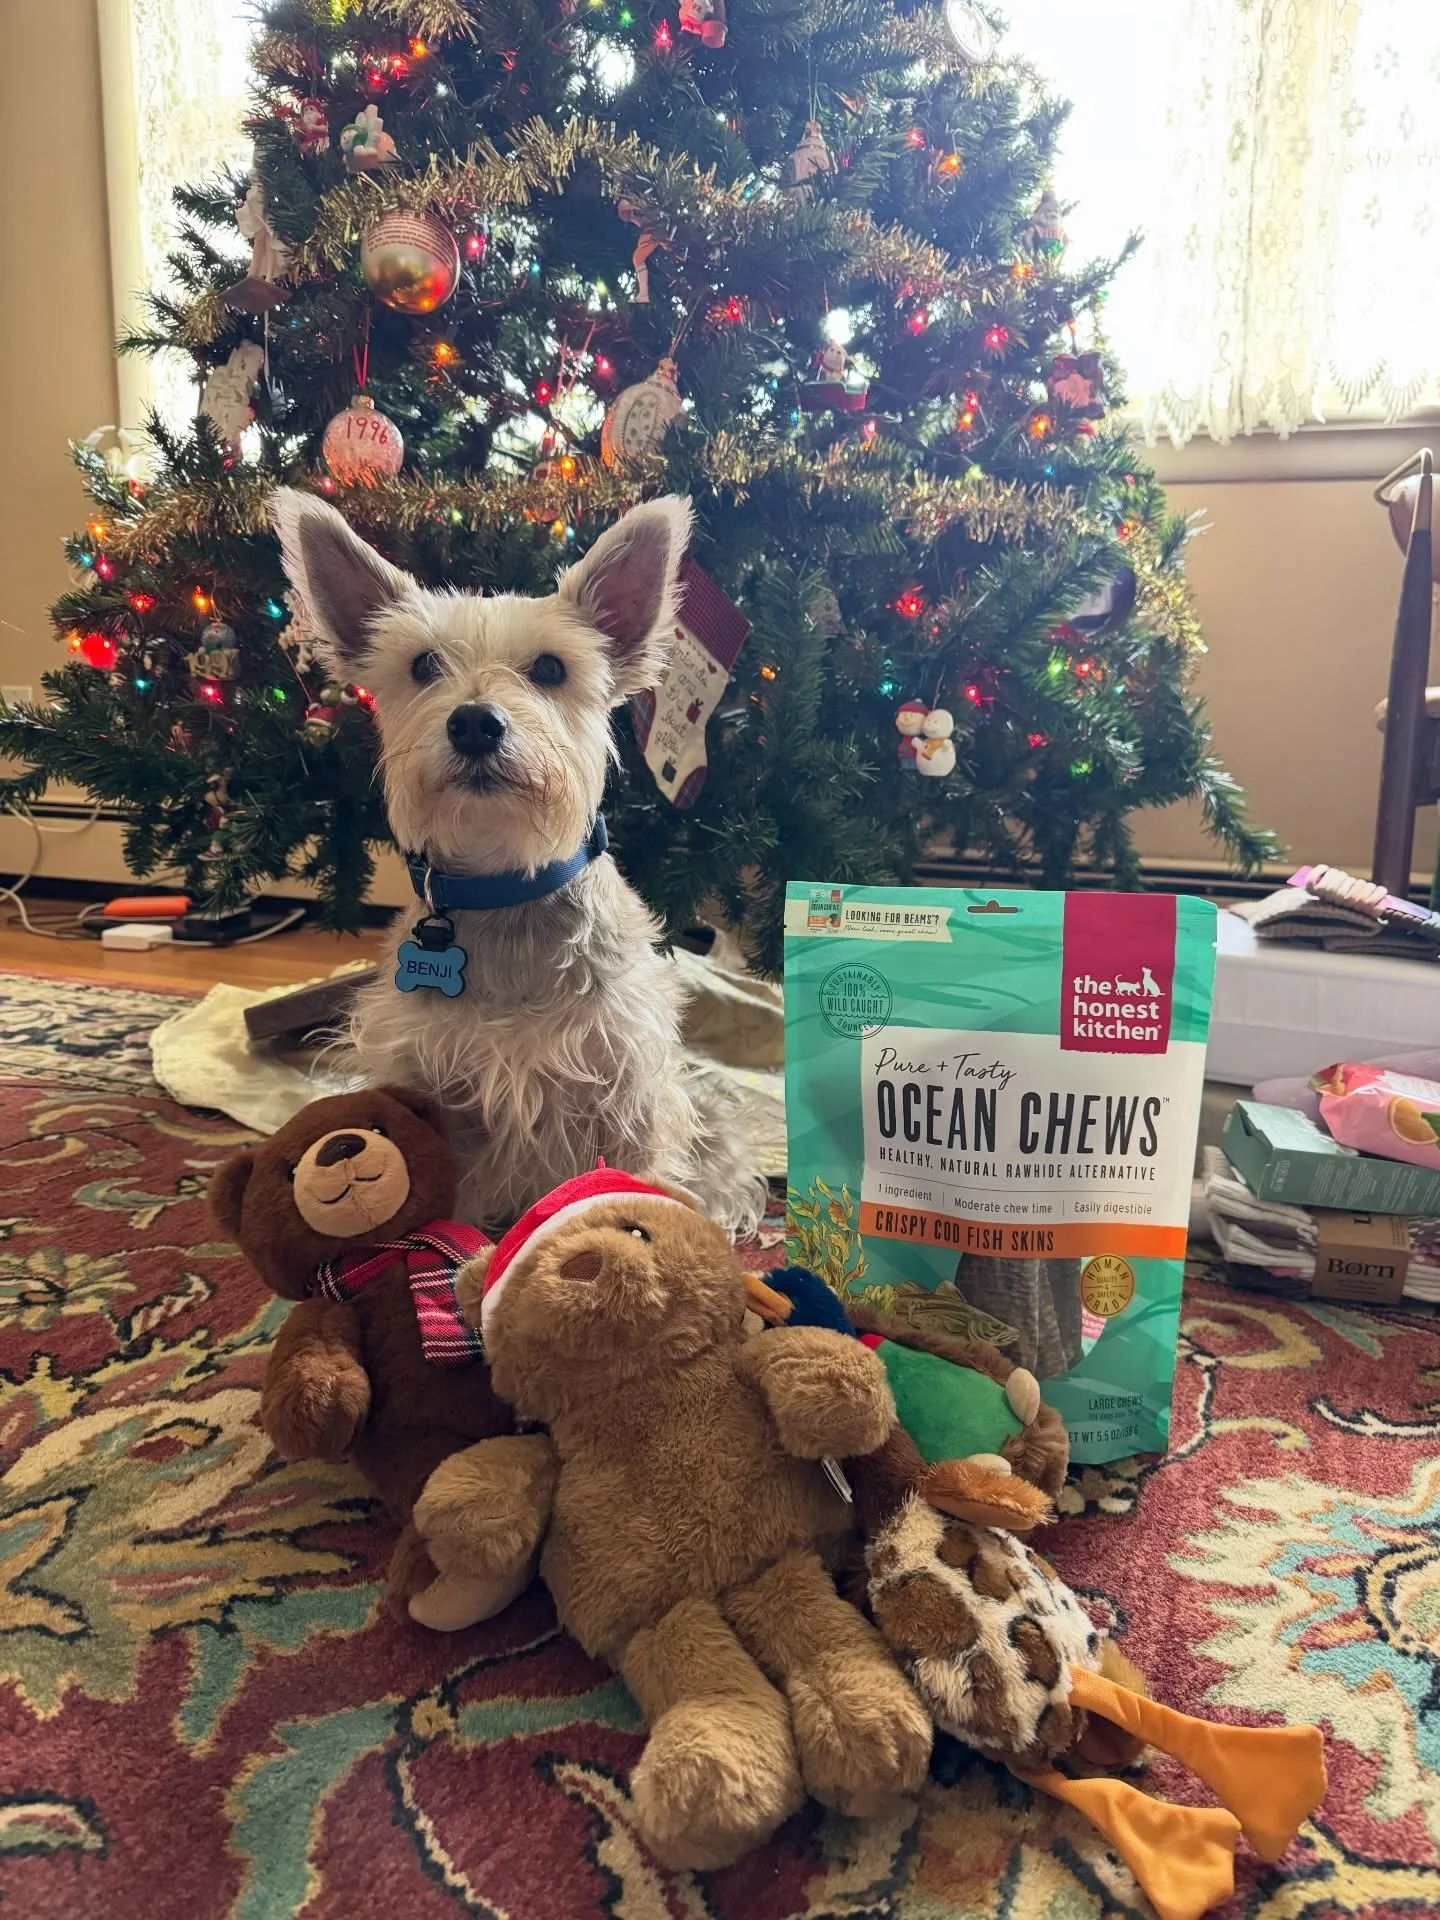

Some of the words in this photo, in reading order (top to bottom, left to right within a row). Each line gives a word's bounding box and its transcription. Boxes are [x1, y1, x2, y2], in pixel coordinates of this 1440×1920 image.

[346, 416, 388, 444] 1996
[846, 910, 880, 922] LOOKING
[885, 912, 901, 923] FOR
[407, 960, 452, 979] BENJI
[829, 970, 881, 991] SUSTAINABLY
[844, 983, 866, 997] 100%
[1073, 975, 1112, 995] the
[828, 997, 847, 1011] WILD
[850, 999, 883, 1014] CAUGHT
[1073, 995, 1160, 1019] honest
[837, 1018, 873, 1032] SOURCED
[875, 1047, 932, 1076] Pure
[936, 1061, 949, 1073] +
[952, 1053, 1017, 1091] Tasty
[877, 1079, 997, 1152] OCEAN
[1018, 1091, 1161, 1157] CHEWS
[940, 1157, 998, 1177] NATURAL
[1006, 1163, 1063, 1178] RAWHIDE
[1069, 1164, 1156, 1181] ALTERNATIVE
[885, 1184, 933, 1201] ingredient
[954, 1197, 1001, 1213] Moderate
[1003, 1202, 1029, 1214] chew
[1032, 1202, 1053, 1213] time
[1074, 1201, 1101, 1214] Easily
[1103, 1202, 1152, 1215] digestible
[875, 1210, 928, 1238] CRISPY
[934, 1219, 961, 1244] COD
[967, 1226, 1003, 1251] FISH
[1011, 1230, 1055, 1252] SKINS
[1085, 1258, 1130, 1281] HUMAN
[1085, 1293, 1129, 1313] GRADE
[1088, 1397, 1116, 1410] LARGE
[1117, 1394, 1144, 1409] CHEWS
[1067, 1431, 1079, 1443] ET
[1081, 1431, 1094, 1443] WT
[1096, 1430, 1110, 1442] 5.5
